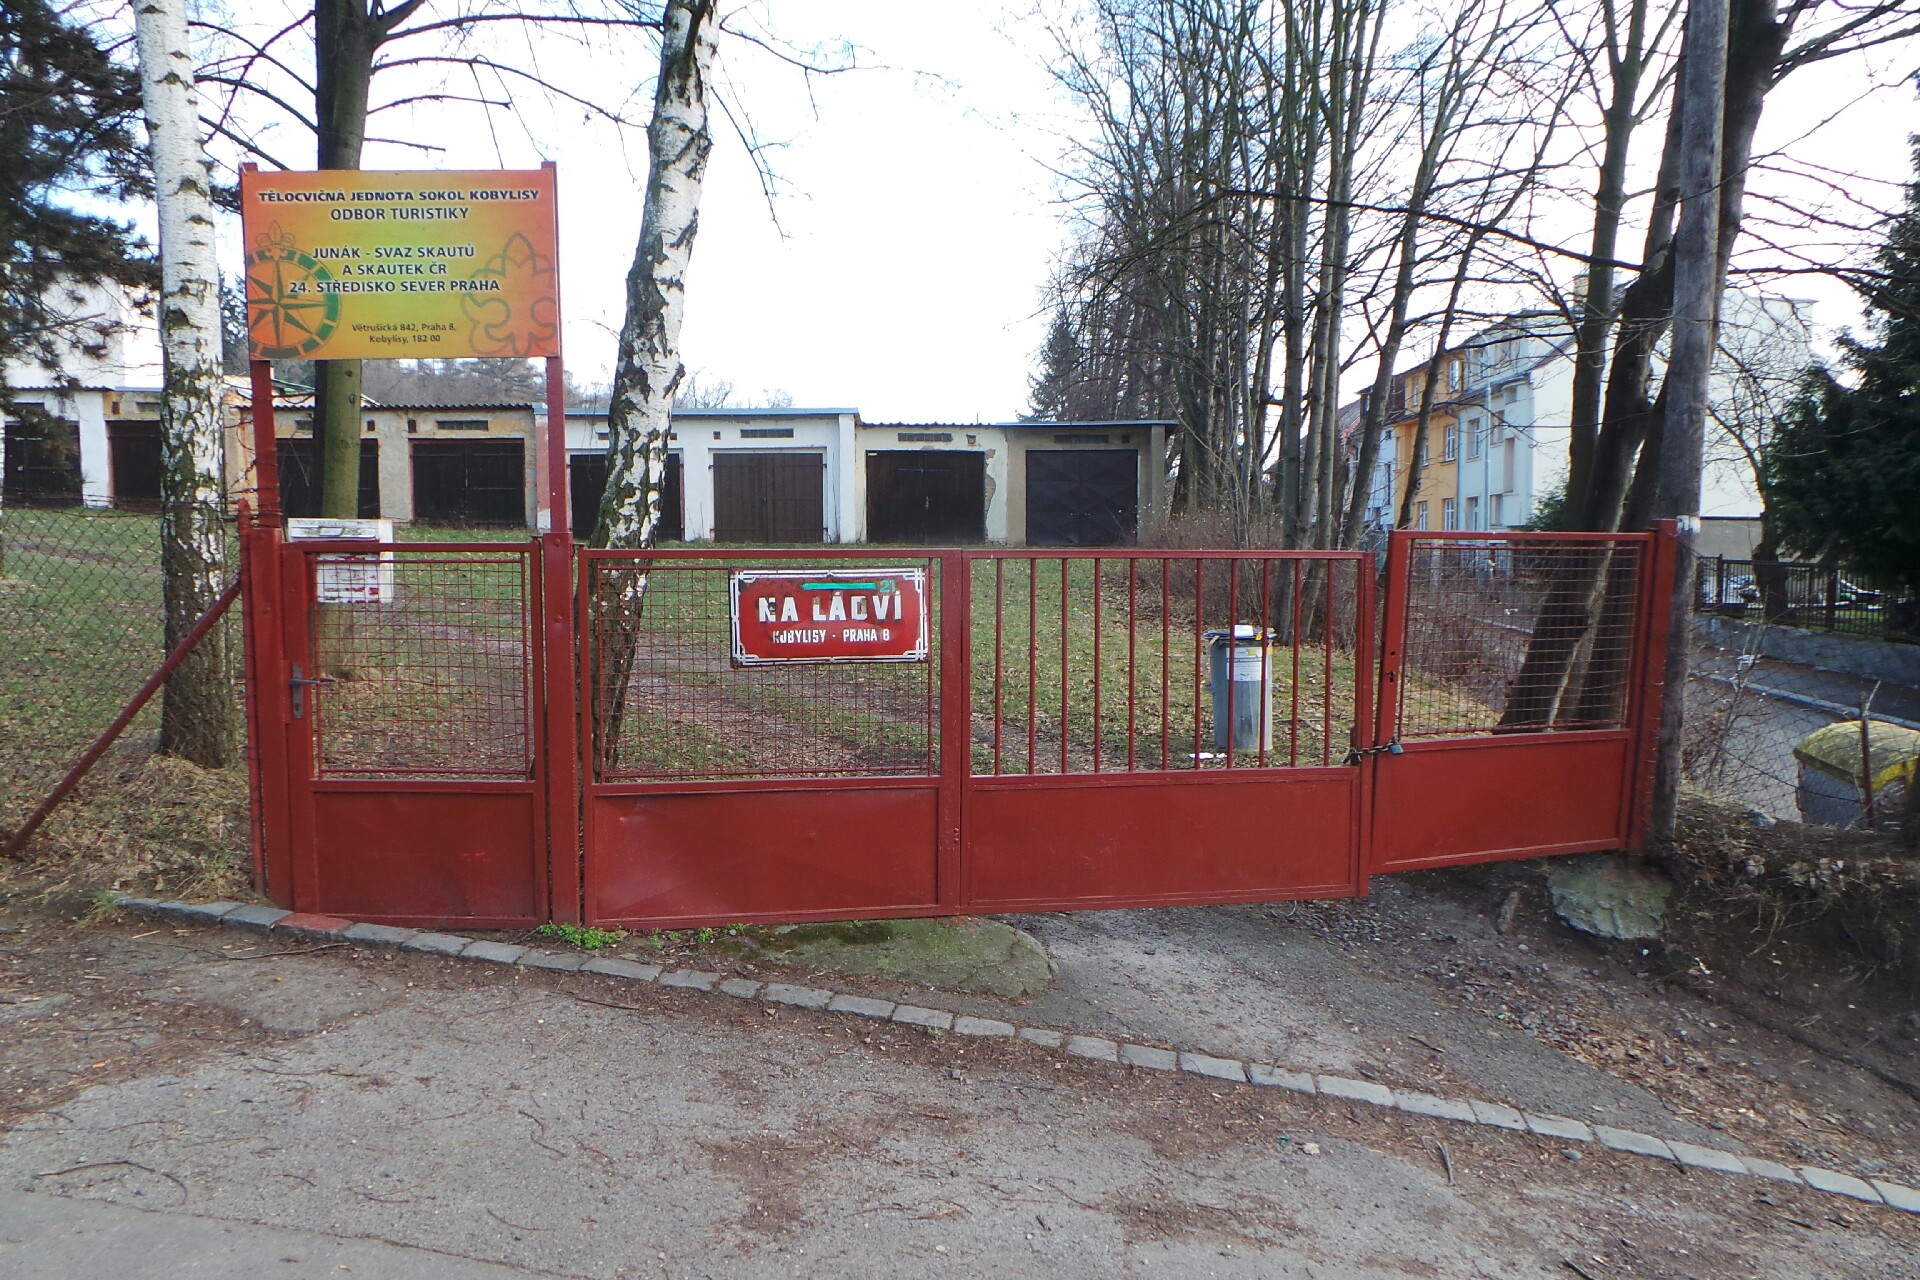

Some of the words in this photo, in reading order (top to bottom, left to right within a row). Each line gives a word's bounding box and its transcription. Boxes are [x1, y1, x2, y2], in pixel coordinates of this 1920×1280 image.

[258, 190, 345, 202] TĚLOCVIČNÁ
[350, 191, 414, 201] JEDNOTA
[418, 191, 465, 200] SOKOL
[469, 190, 539, 200] KOBYLISY
[330, 208, 386, 220] ODBOR
[390, 207, 469, 219] TURISTIKY
[312, 244, 361, 258] JUNÁK
[374, 247, 413, 258] SVAZ
[417, 243, 474, 257] SKAUTŮ
[342, 264, 352, 275] A
[357, 264, 423, 275] SKAUTEK
[428, 261, 448, 274] ČR
[289, 282, 311, 292] 24.
[316, 279, 396, 292] STŘEDISKO
[400, 281, 446, 291] SEVER
[450, 280, 500, 291] PRAHA
[352, 323, 398, 332] Větrušická
[400, 323, 419, 332] 842,
[421, 323, 447, 331] Praha
[369, 334, 409, 345] Kobylisy,
[430, 334, 441, 342] 00
[758, 597, 799, 622] NA
[812, 591, 902, 621] LÁDVÍ
[772, 629, 827, 644] KOBYLISY
[843, 629, 878, 642] PRAHA
[882, 628, 890, 641] 8
